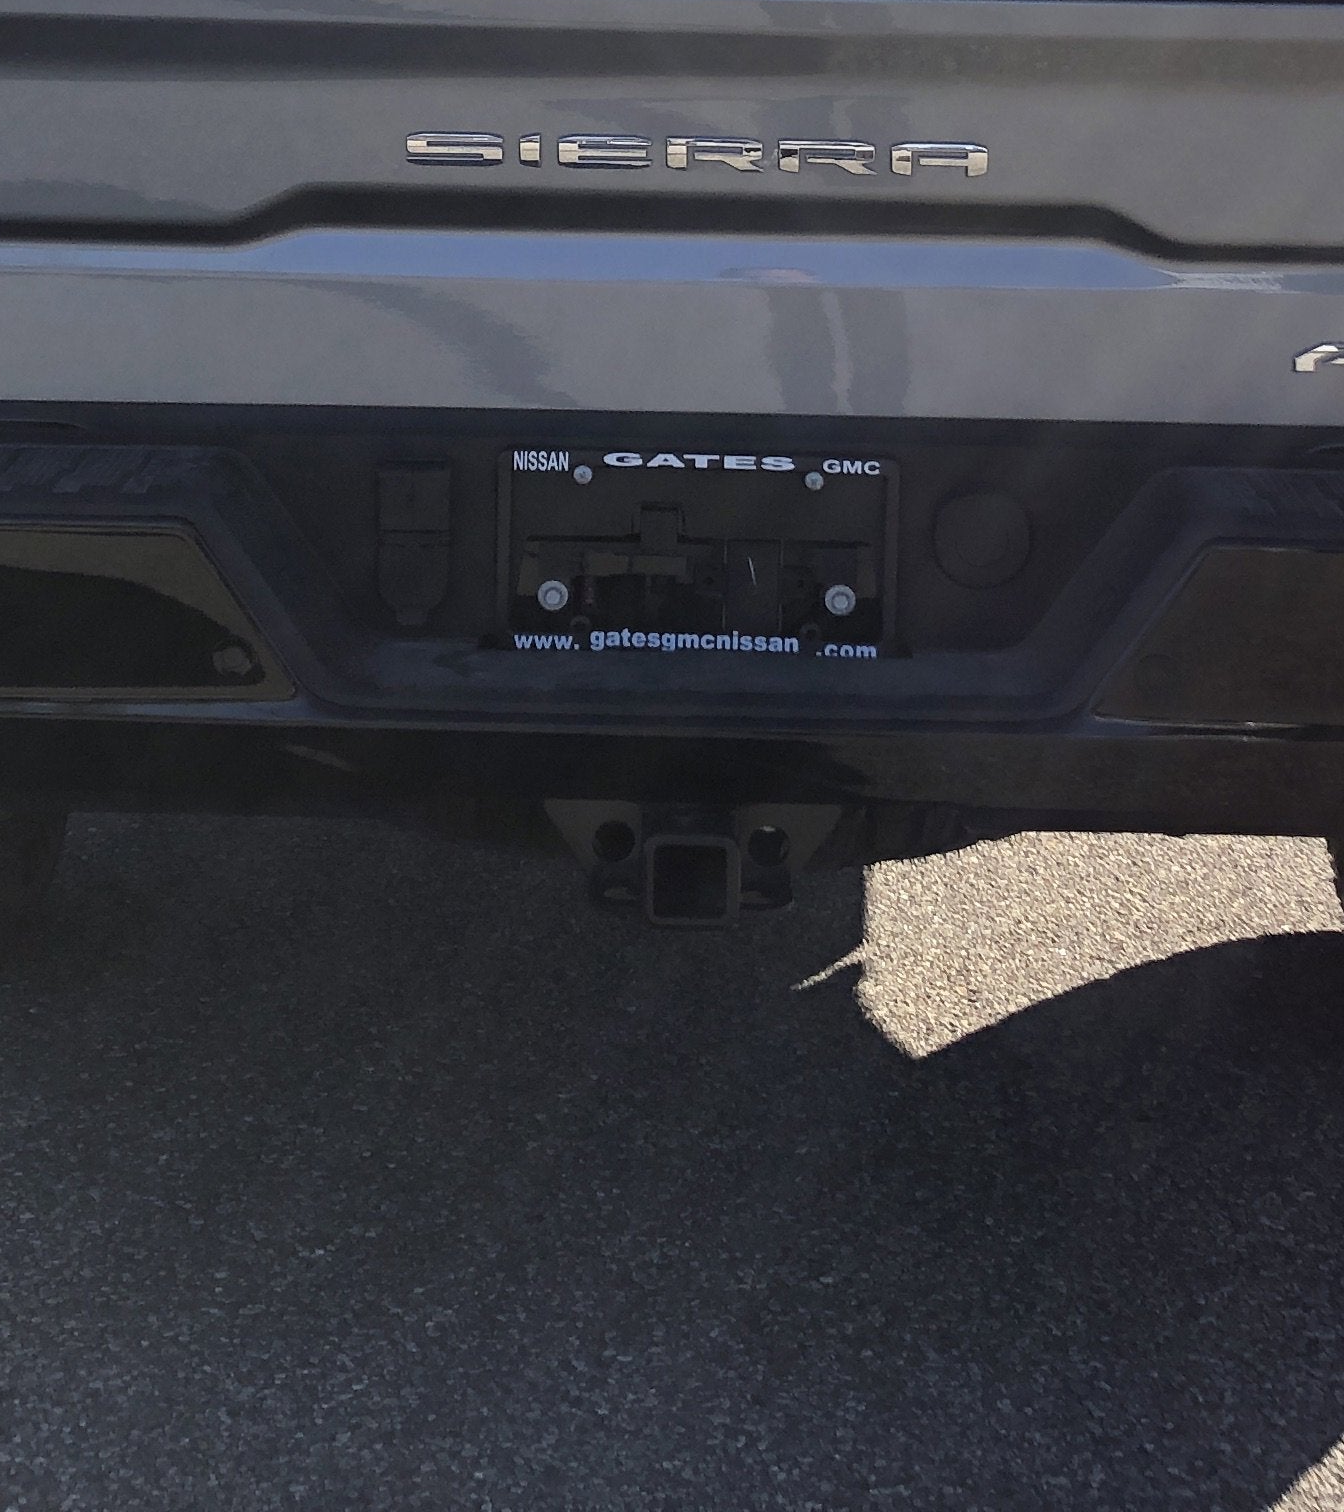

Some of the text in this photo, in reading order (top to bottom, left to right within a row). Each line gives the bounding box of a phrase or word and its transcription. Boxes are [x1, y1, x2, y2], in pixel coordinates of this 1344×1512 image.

[404, 131, 990, 176] SIERRA
[513, 450, 880, 475] NISSAN GATES GMC
[514, 628, 877, 658] www. gatesgmcnissan .com
